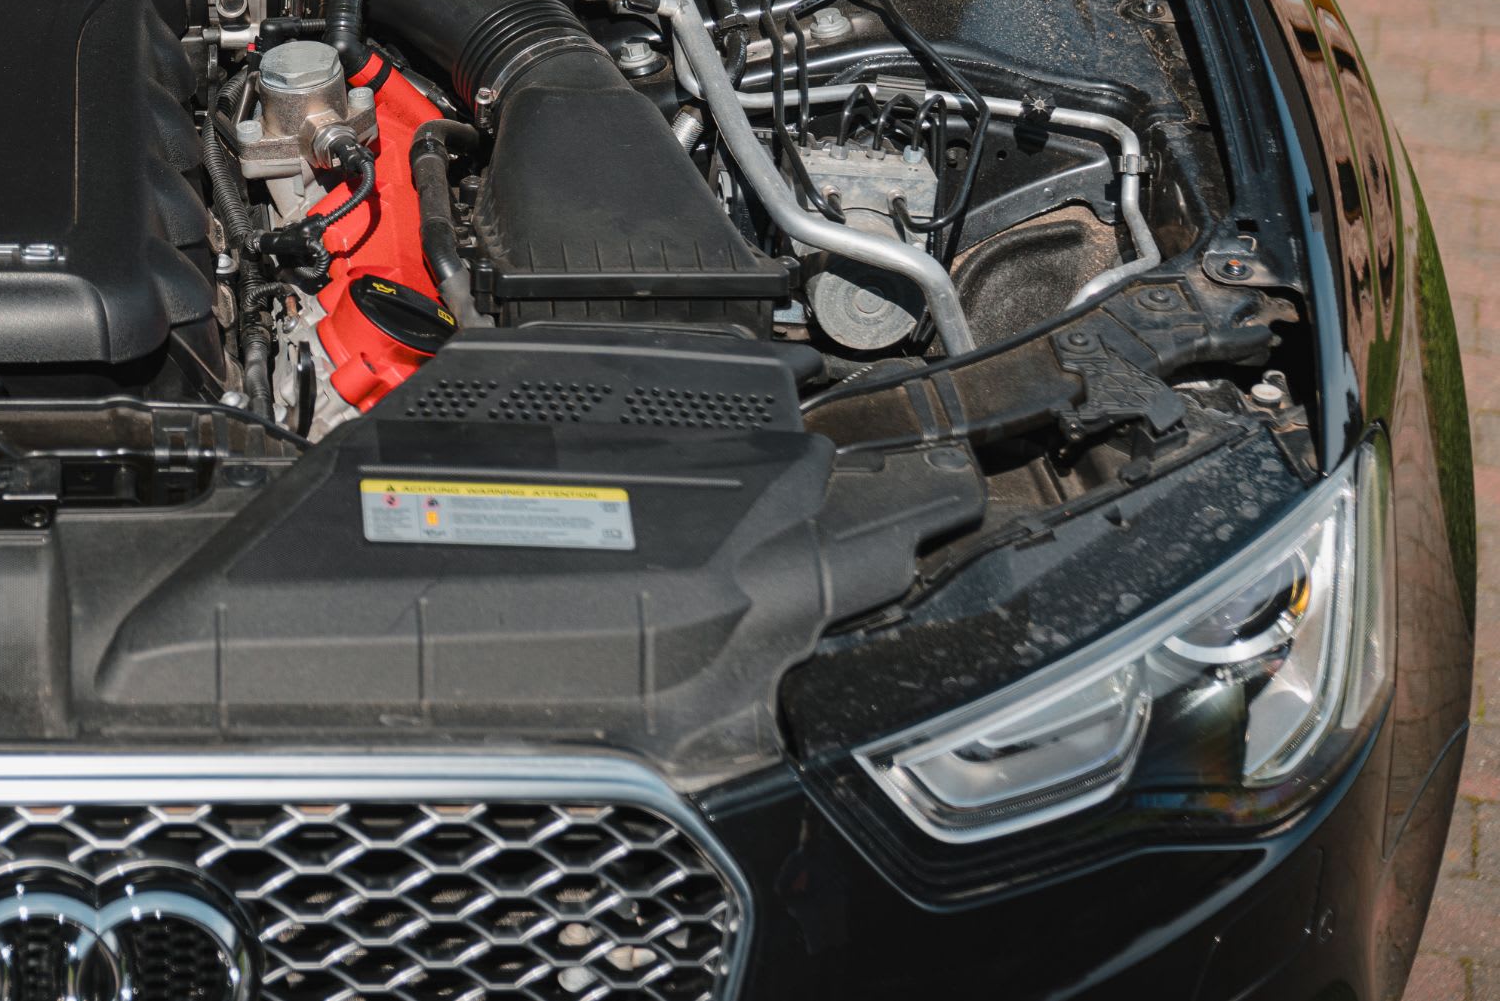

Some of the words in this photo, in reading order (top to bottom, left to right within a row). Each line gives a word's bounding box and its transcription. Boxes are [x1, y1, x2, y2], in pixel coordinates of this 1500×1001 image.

[404, 485, 461, 495] ACHTUNG
[466, 487, 525, 497] WARNING
[531, 489, 598, 499] ATTENTION
